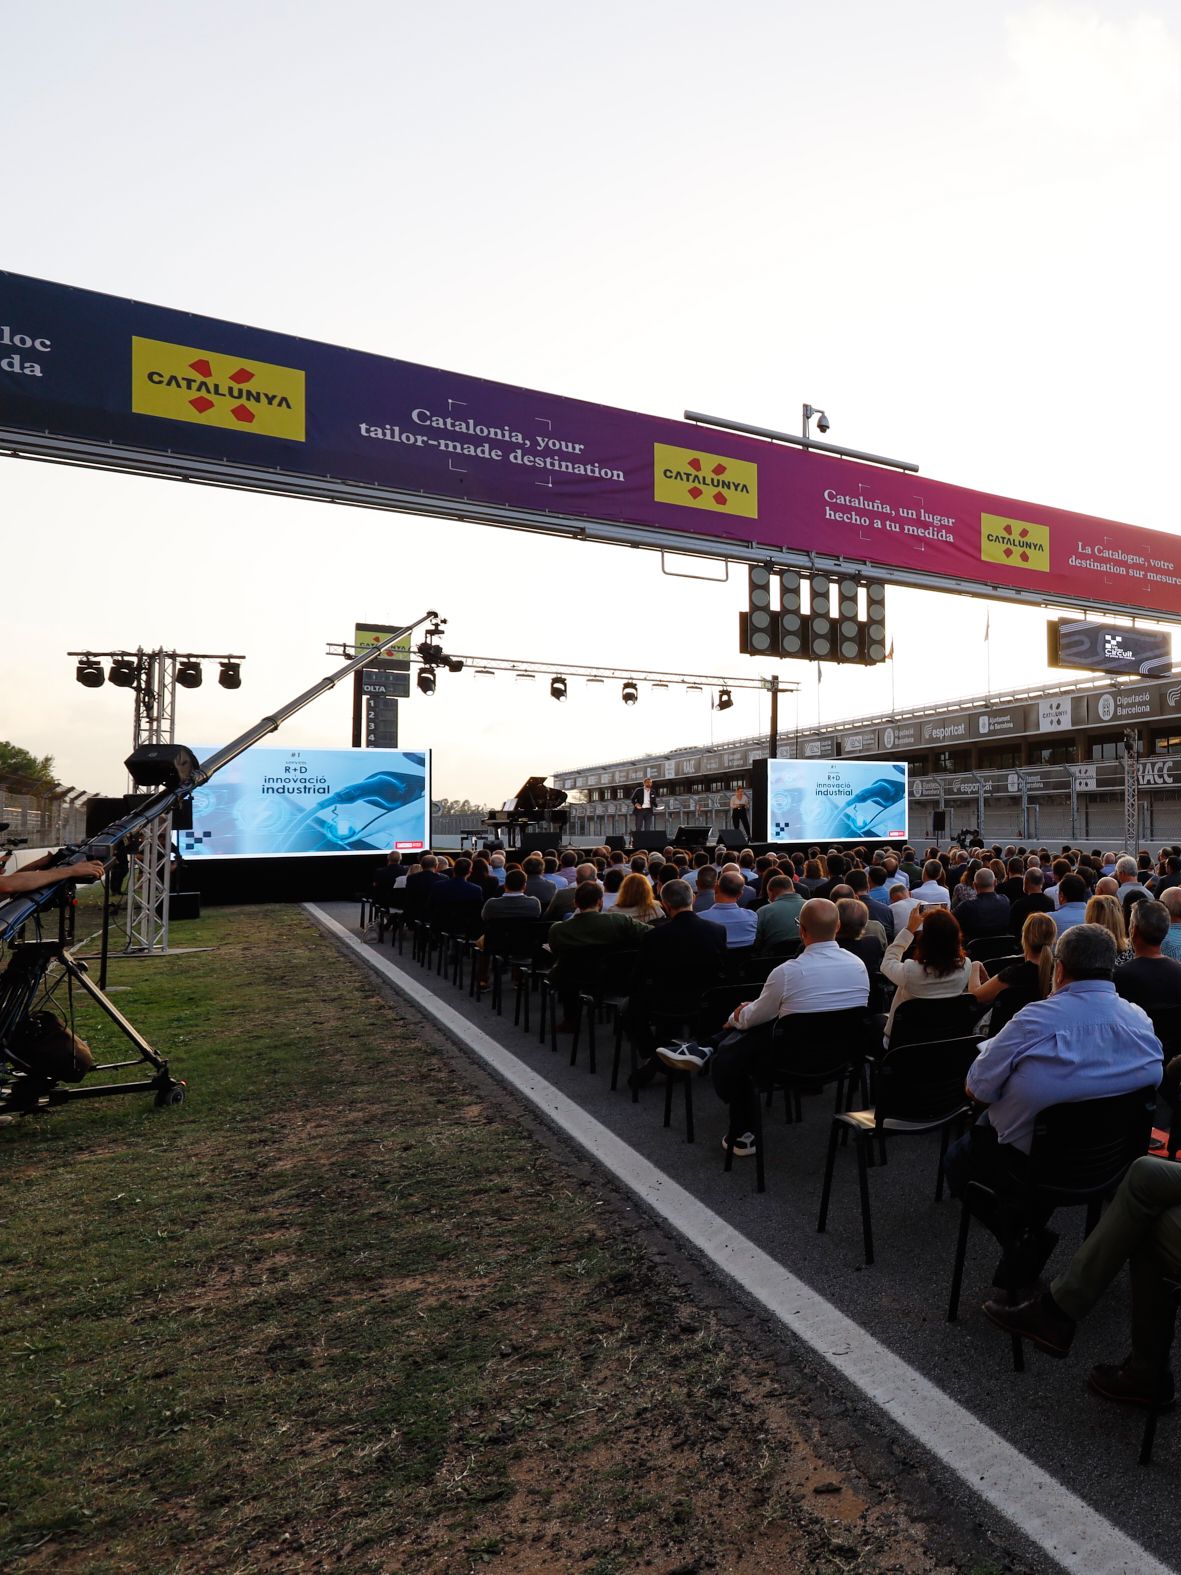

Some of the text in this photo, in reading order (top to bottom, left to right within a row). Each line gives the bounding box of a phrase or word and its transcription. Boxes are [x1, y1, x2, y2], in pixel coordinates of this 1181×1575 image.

[0, 326, 52, 352] loc
[0, 355, 43, 377] da
[147, 371, 293, 410] CATALUNYA
[411, 408, 585, 456] Catalonia, your
[359, 421, 625, 483] tailor-made destination
[663, 468, 750, 495] CATALUNYA
[823, 489, 955, 529] Cataluña, un lugar
[825, 507, 954, 543] hecho a tu medida
[986, 533, 1044, 553] CATALUNYA
[1078, 541, 1174, 571] La Catalogne, votre
[1068, 555, 1181, 585] destination sur mesure
[1117, 692, 1150, 705] Diputació
[1117, 705, 1150, 716] Barcelona
[932, 722, 965, 740] esportcat
[264, 776, 327, 784] innovació
[284, 766, 308, 774] R+D
[261, 785, 330, 794] industrial
[815, 788, 853, 797] industrial
